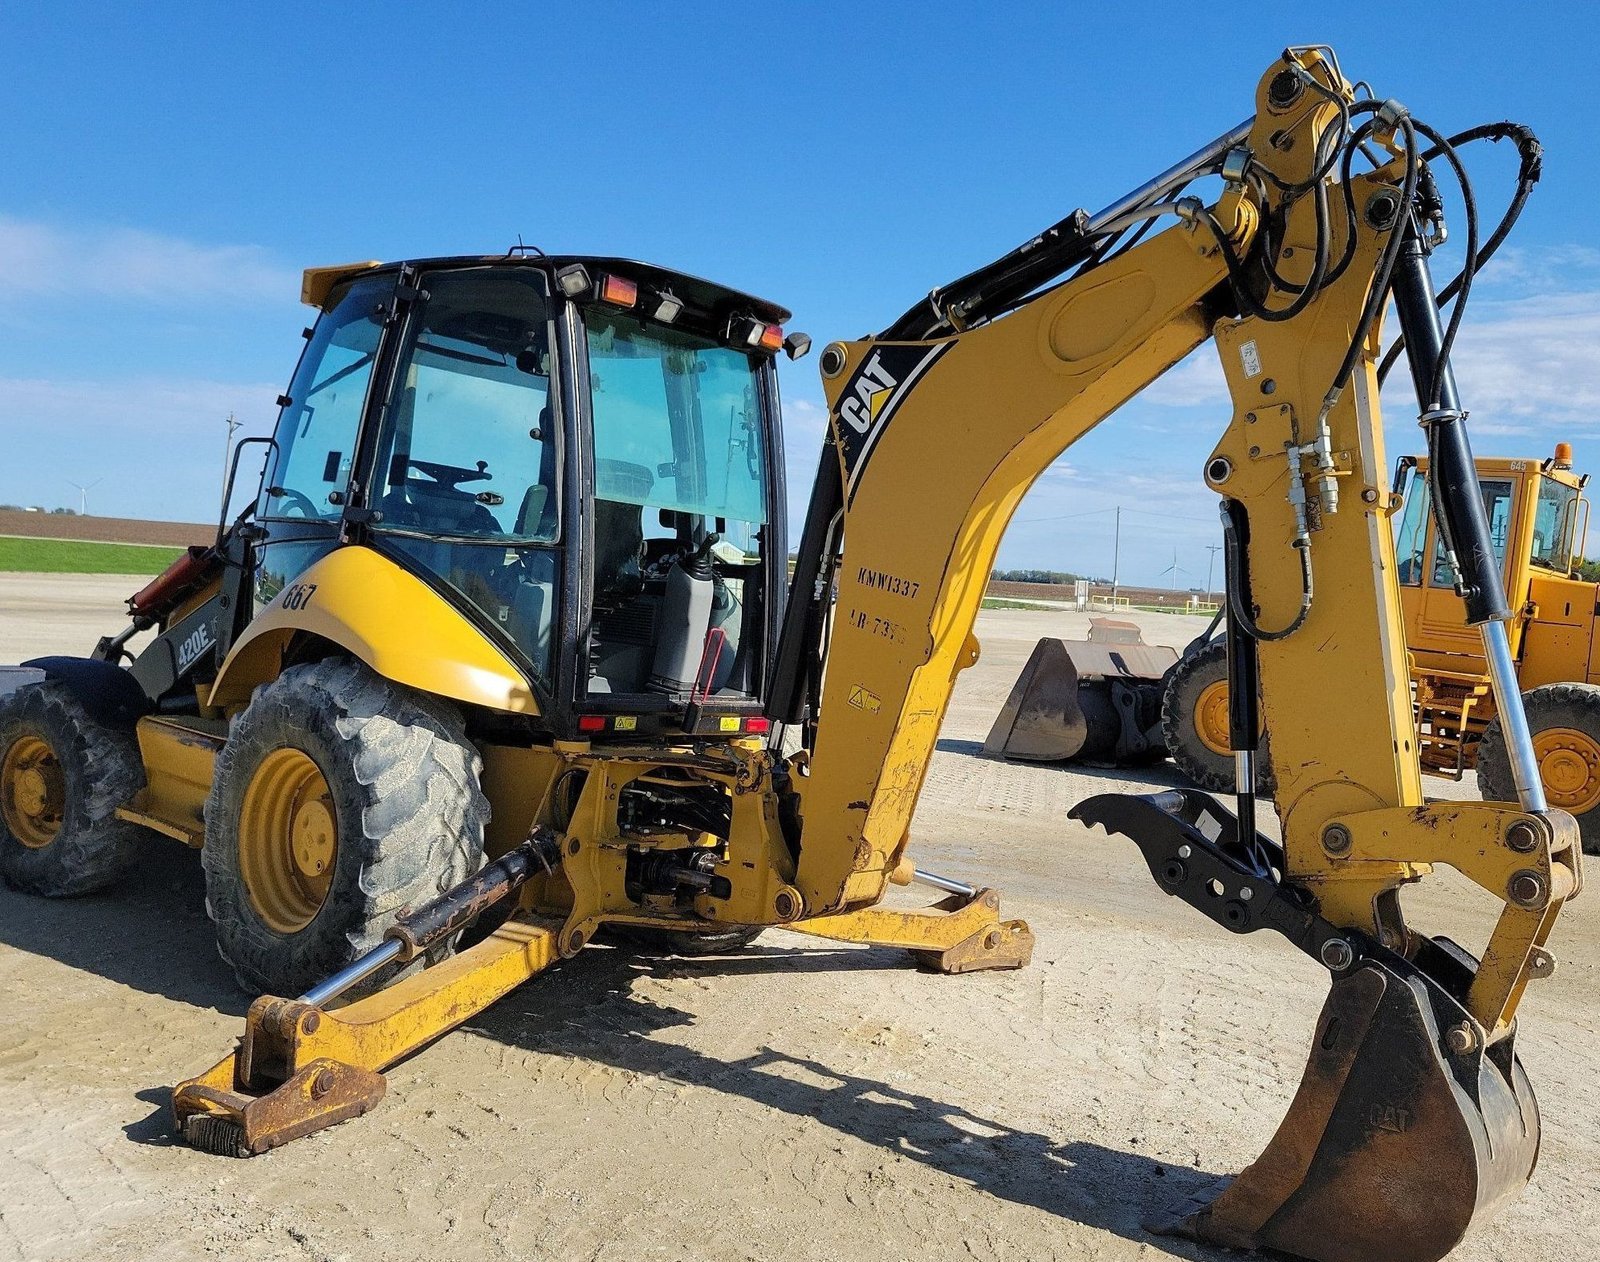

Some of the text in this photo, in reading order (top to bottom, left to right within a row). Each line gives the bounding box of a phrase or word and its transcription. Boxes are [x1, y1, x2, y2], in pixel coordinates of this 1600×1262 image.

[840, 350, 898, 434] CAT
[1510, 461, 1527, 471] 645
[282, 585, 317, 610] 667
[178, 623, 210, 665] 420E
[1369, 1103, 1410, 1132] CAT
